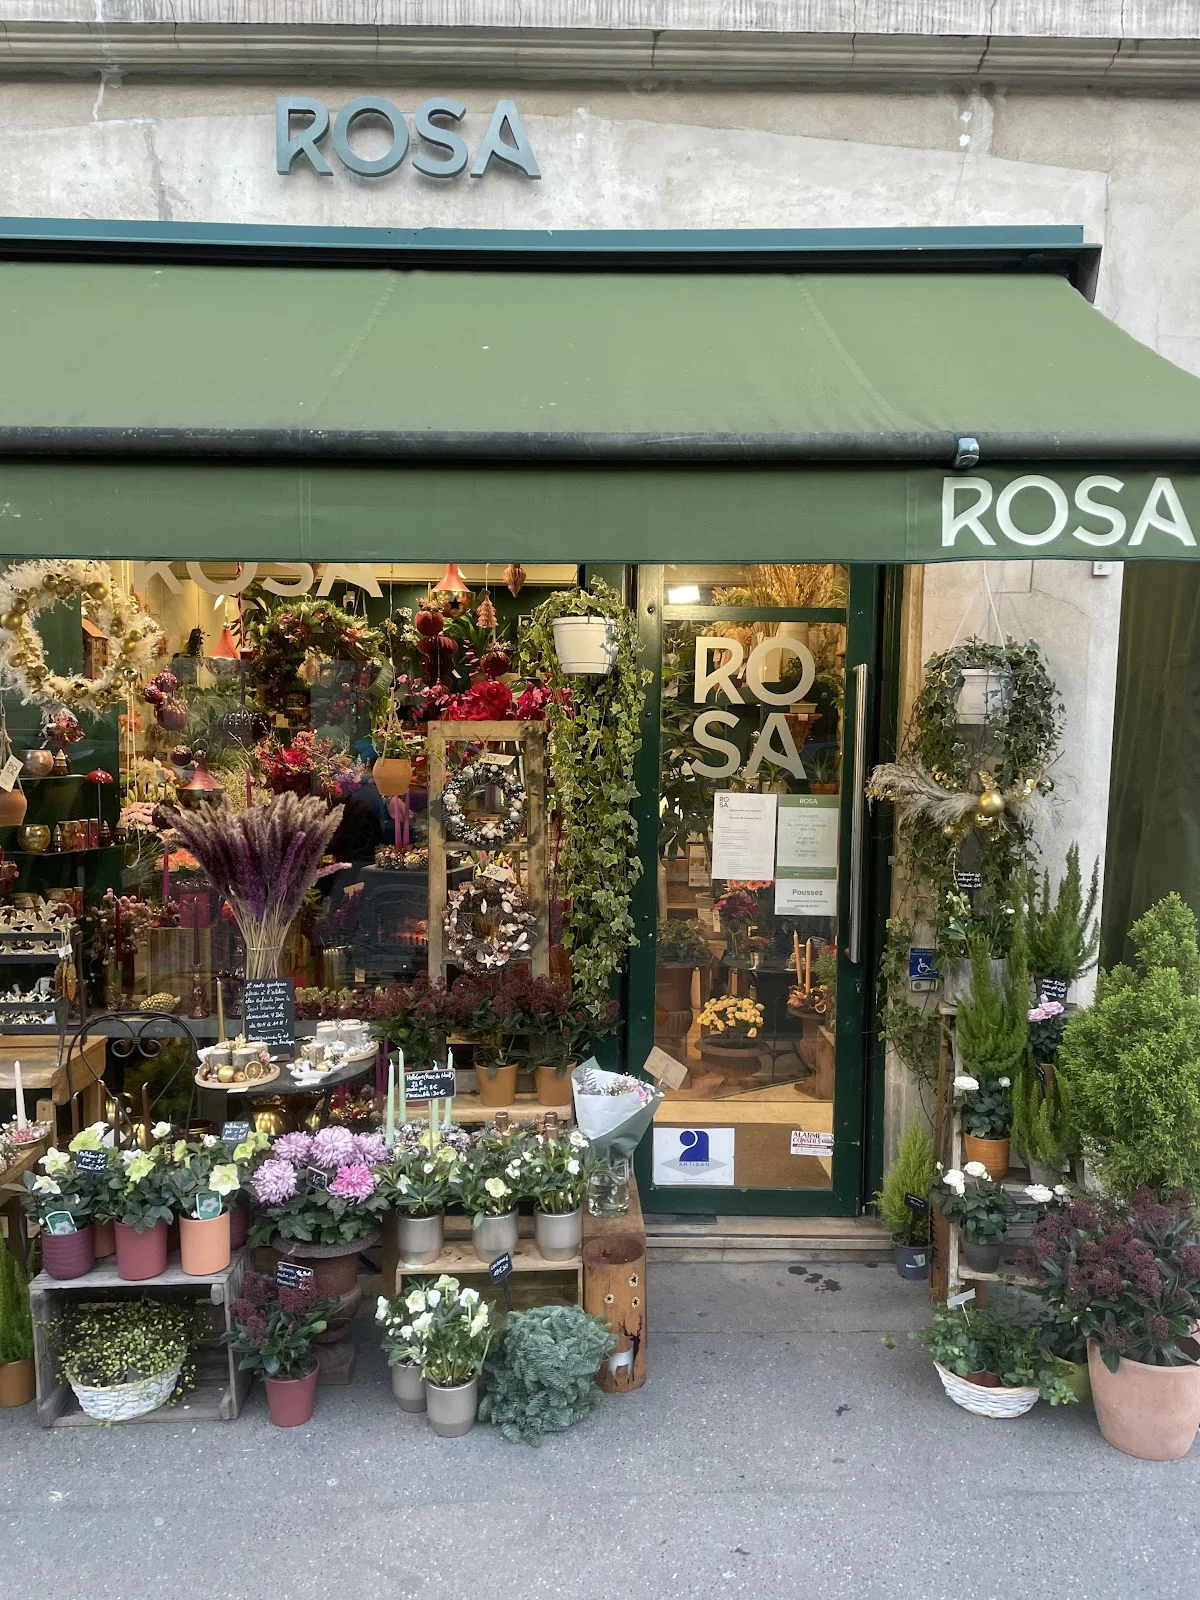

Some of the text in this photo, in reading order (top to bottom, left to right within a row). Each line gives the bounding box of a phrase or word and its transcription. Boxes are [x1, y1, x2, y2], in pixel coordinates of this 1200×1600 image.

[276, 95, 542, 179] ROSA
[942, 474, 1198, 547] ROSA
[694, 636, 816, 706] RO
[690, 710, 808, 779] SA
[792, 888, 823, 896] Poussez
[246, 1012, 269, 1020] dimanche
[793, 1131, 821, 1139] ALARME
[793, 1137, 821, 1145] CONSEILS
